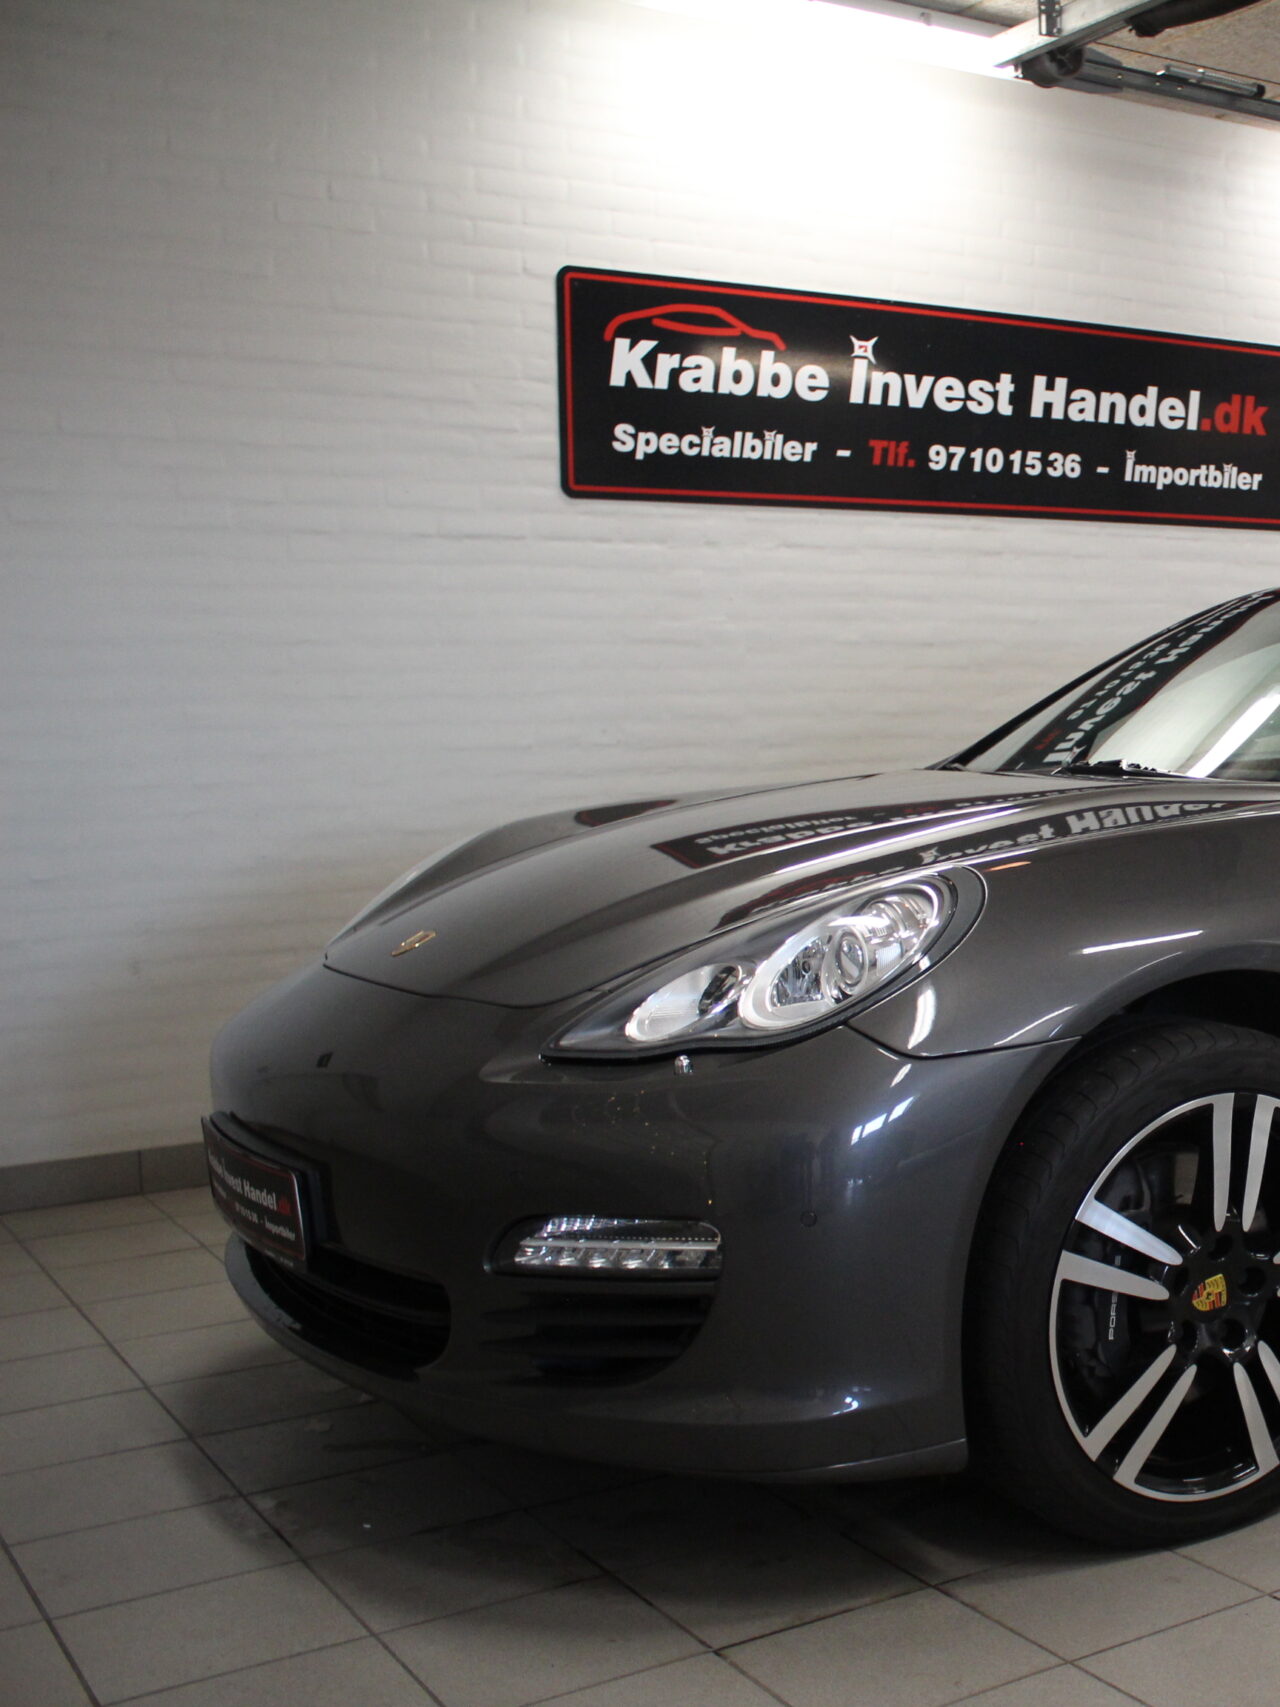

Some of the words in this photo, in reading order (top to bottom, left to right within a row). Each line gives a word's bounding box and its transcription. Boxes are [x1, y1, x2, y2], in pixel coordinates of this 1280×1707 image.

[608, 337, 830, 402] Krabbe
[849, 336, 1014, 416] Invest
[1030, 374, 1269, 436] Handel.dk
[611, 423, 818, 462] Specialbiler
[868, 439, 916, 468] Tlf.
[1124, 450, 1263, 490] Importbiler
